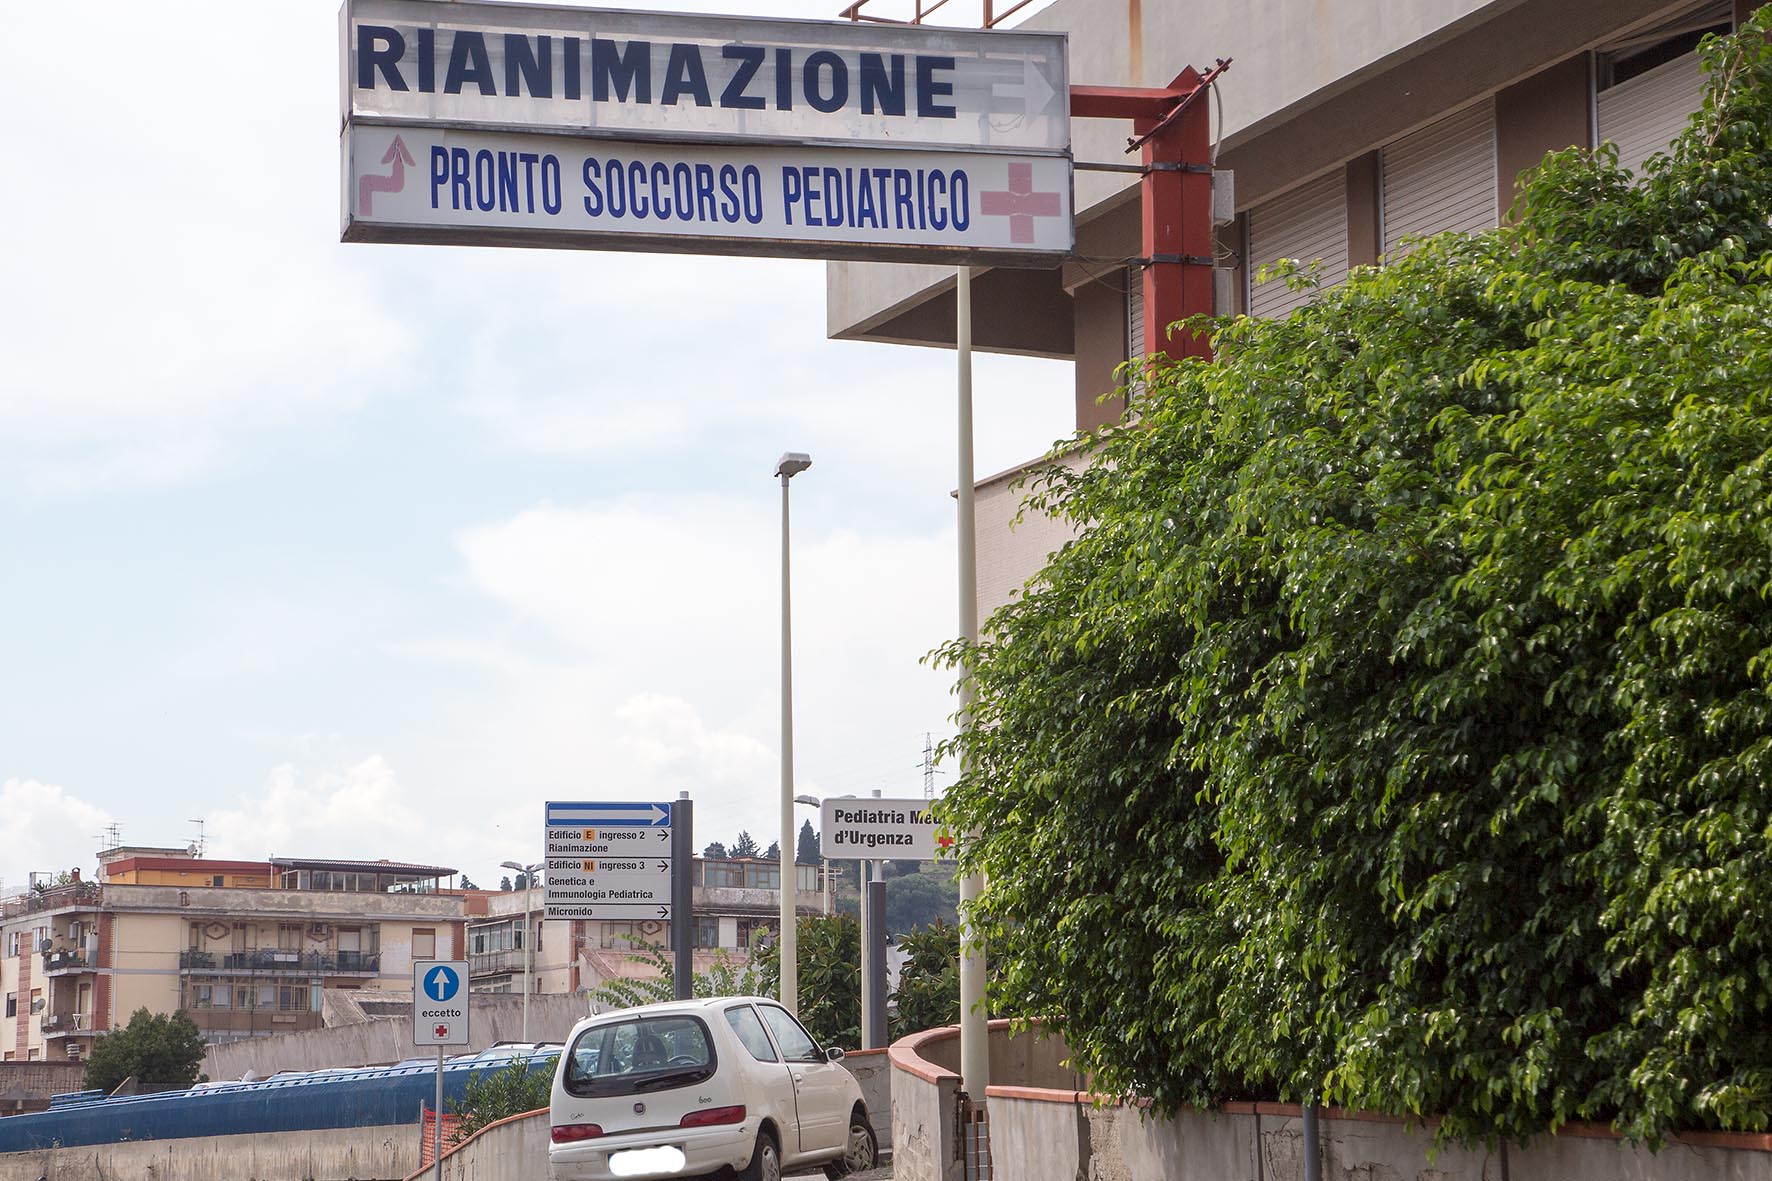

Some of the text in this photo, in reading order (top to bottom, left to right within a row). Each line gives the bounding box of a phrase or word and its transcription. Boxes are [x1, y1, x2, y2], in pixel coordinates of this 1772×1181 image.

[357, 24, 956, 118] RIANIMAZIONE
[430, 145, 970, 233] PRONTO SOCCORSO PEDIATRICO
[834, 809, 905, 824] Pediatria
[548, 830, 645, 841] Edificio E ingresso 2
[834, 830, 913, 847] d'Urgenza
[548, 843, 609, 853] Rianimazione
[548, 860, 645, 871] Edificio NI ingresso 3
[548, 877, 587, 885] Genetica
[548, 890, 653, 900] Immunologia Pediatrica
[548, 907, 593, 916] Micronido
[422, 1009, 461, 1017] eccetto
